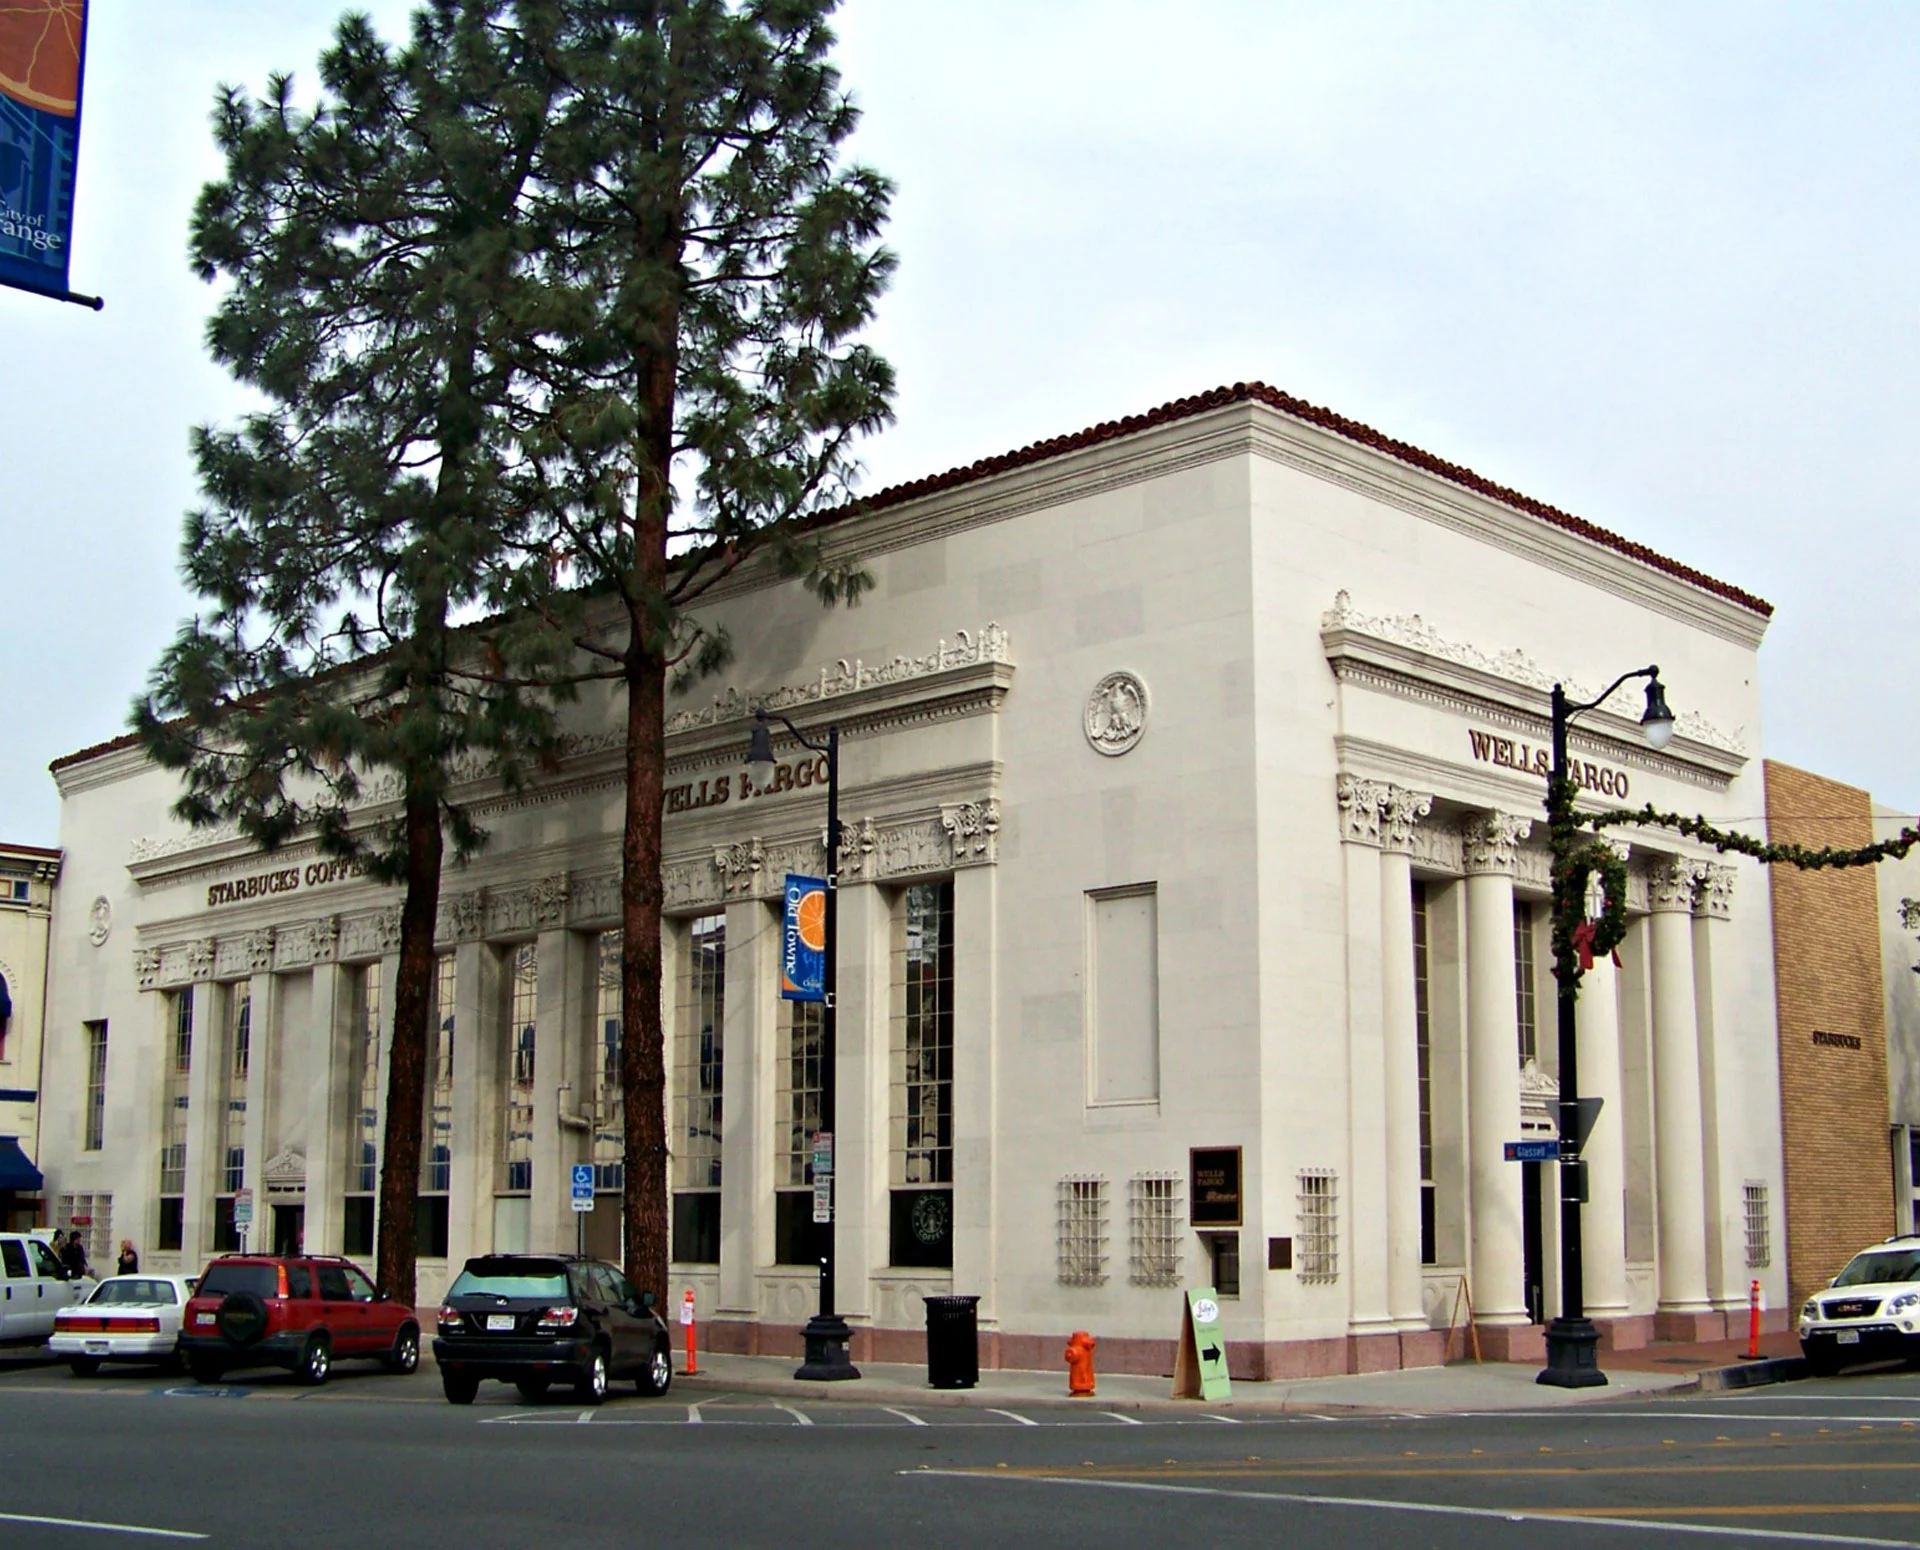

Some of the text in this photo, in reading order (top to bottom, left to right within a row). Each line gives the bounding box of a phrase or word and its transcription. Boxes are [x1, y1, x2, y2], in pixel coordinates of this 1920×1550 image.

[0, 218, 62, 251] ange
[26, 214, 46, 228] of
[1468, 728, 1629, 800] WELLS ARGO
[663, 775, 731, 815] ELLS
[207, 857, 370, 907] STARBUCKS COFFE
[786, 887, 801, 975] Old Towne
[1812, 1030, 1862, 1050] STARBUCKS
[1516, 1145, 1547, 1158] Glassell
[1837, 1303, 1863, 1313] GMC
